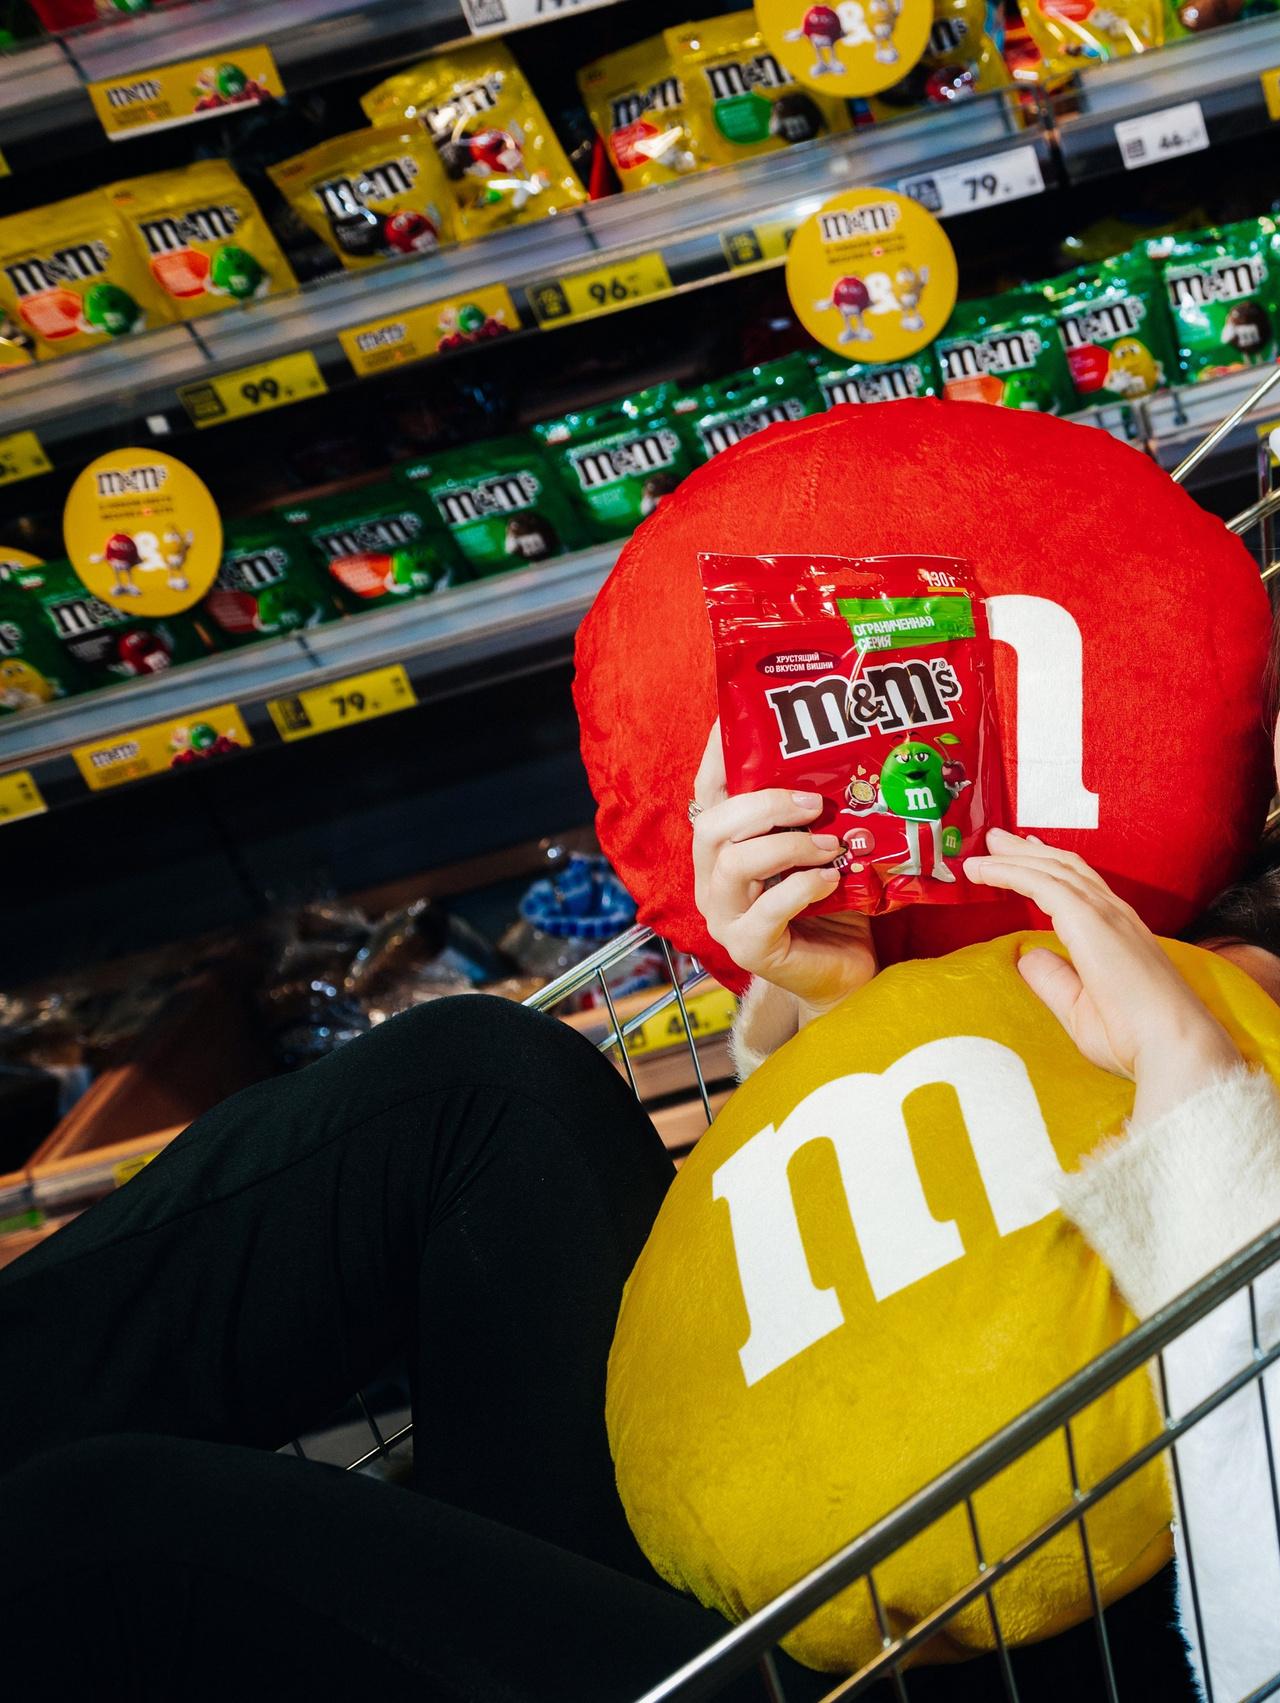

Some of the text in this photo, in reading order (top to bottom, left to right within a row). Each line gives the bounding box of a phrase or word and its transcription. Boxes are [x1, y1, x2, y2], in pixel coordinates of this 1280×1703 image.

[927, 18, 967, 55] m's
[705, 52, 795, 99] m&m
[313, 156, 419, 218] m&m's
[139, 205, 240, 253] m&m's
[821, 202, 898, 241] m&m's
[4, 240, 110, 297] m&m's
[1170, 262, 1265, 306] m&m's
[945, 331, 1040, 379] m&m's
[578, 430, 679, 485] m&m's
[97, 465, 167, 496] m&m's
[439, 471, 538, 523] m&m's
[320, 513, 420, 556] m&m's
[853, 615, 935, 637] ОГРАНИЧЕННАЯ
[857, 634, 892, 651] СЕРИЯ
[764, 661, 834, 674] СО ВКУСОМ ВИШНИ
[776, 651, 820, 664] ХРУСТЯЩИЙ
[329, 689, 366, 719] 79
[770, 661, 960, 755] m&m's
[905, 786, 936, 811] m
[851, 837, 867, 850] m
[945, 834, 957, 849] m
[712, 1034, 1066, 1389] m
